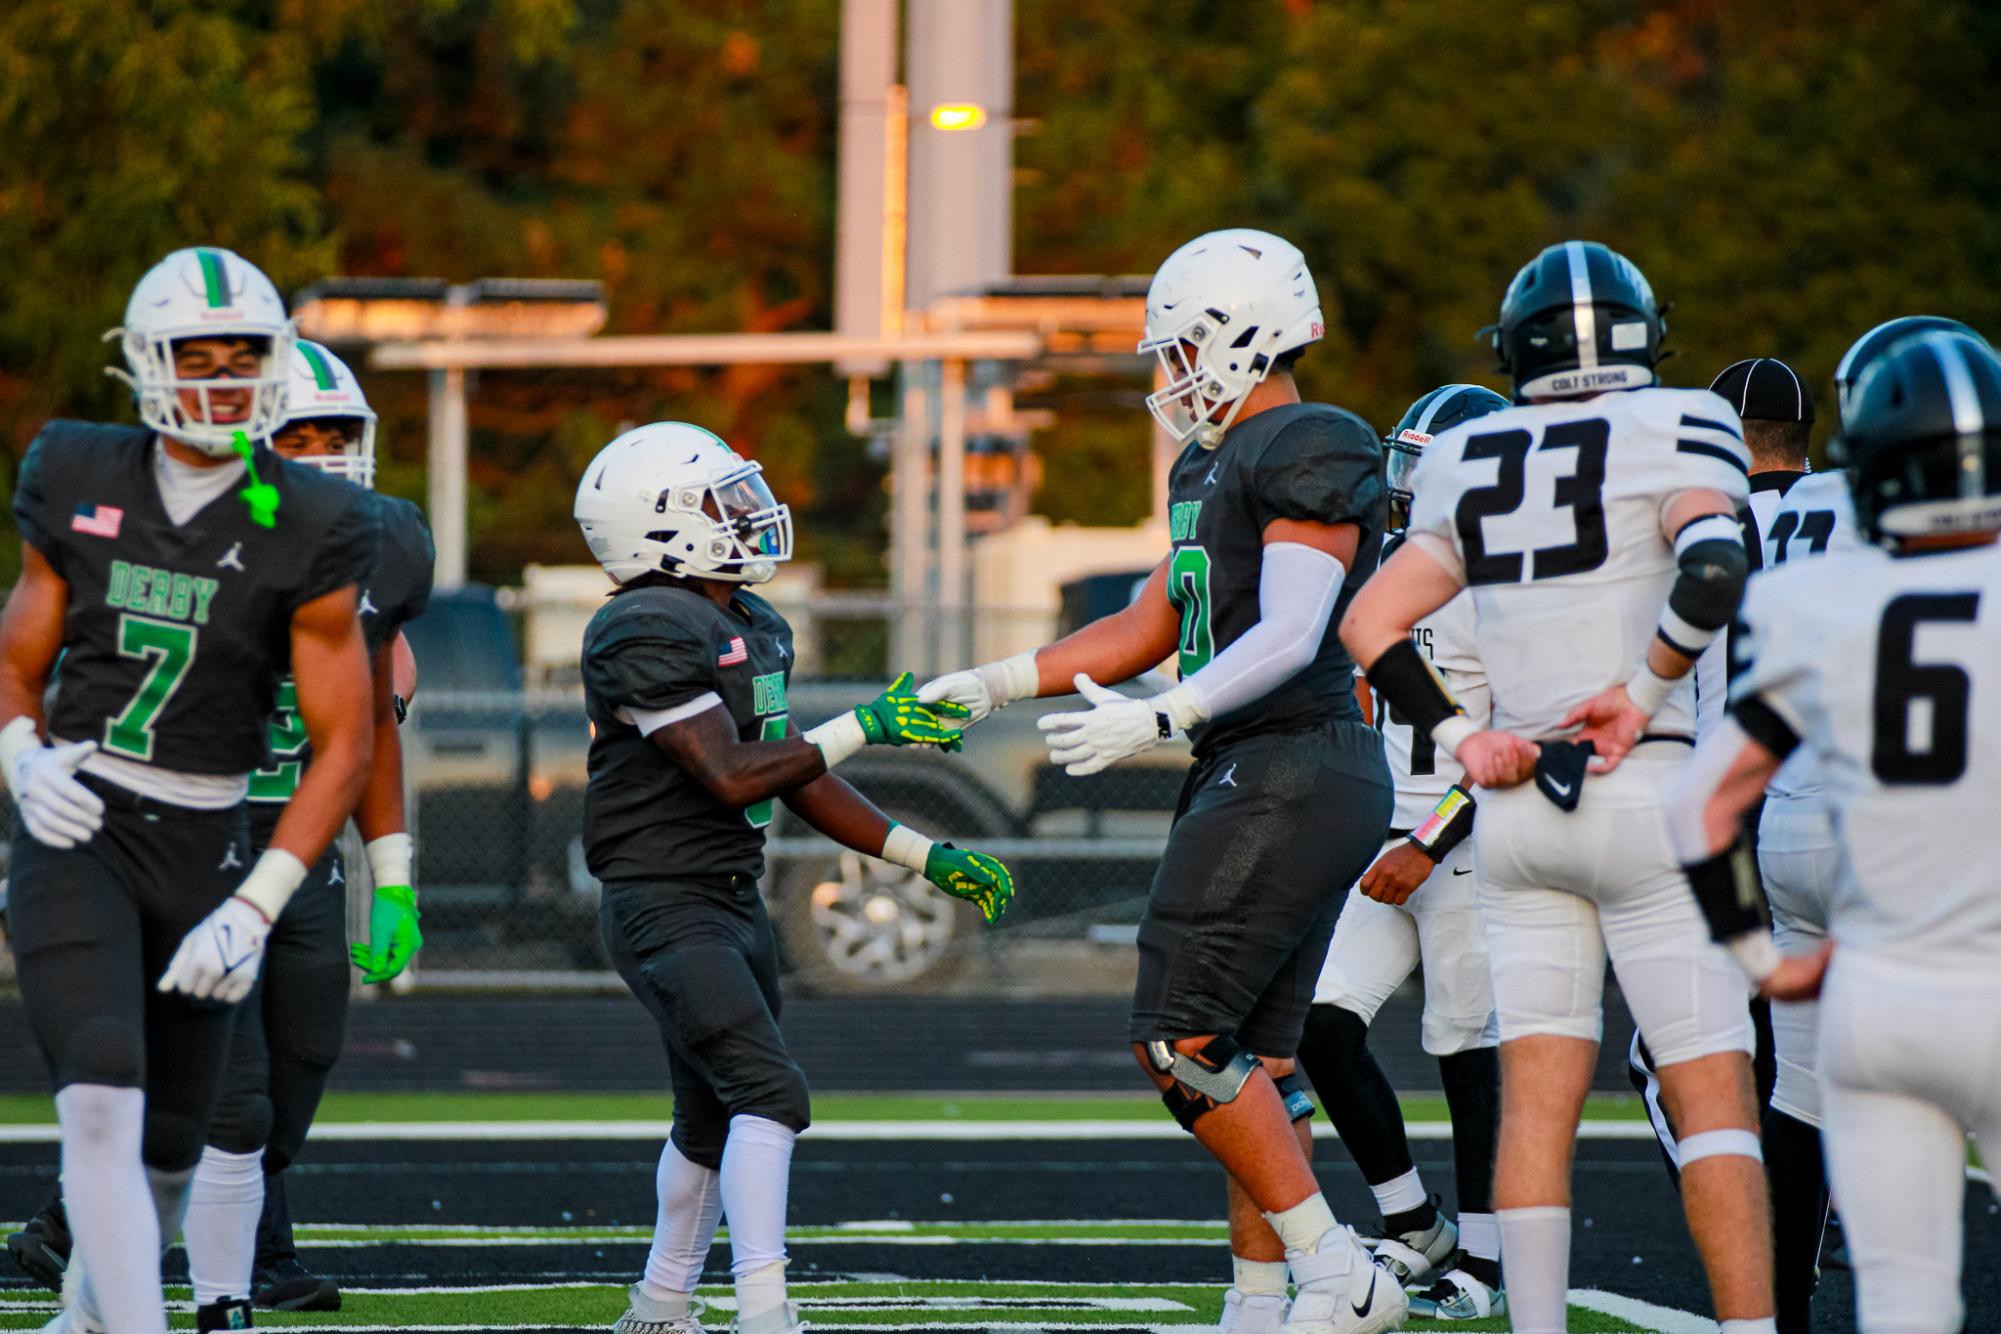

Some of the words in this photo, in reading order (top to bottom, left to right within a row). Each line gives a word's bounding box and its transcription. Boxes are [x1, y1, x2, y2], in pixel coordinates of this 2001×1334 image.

[1402, 430, 1431, 443] Riddell
[1552, 376, 1578, 391] COLT
[1455, 417, 1610, 586] 23
[106, 560, 219, 624] DERBY
[103, 612, 197, 761] 7
[1870, 589, 1981, 785] 6
